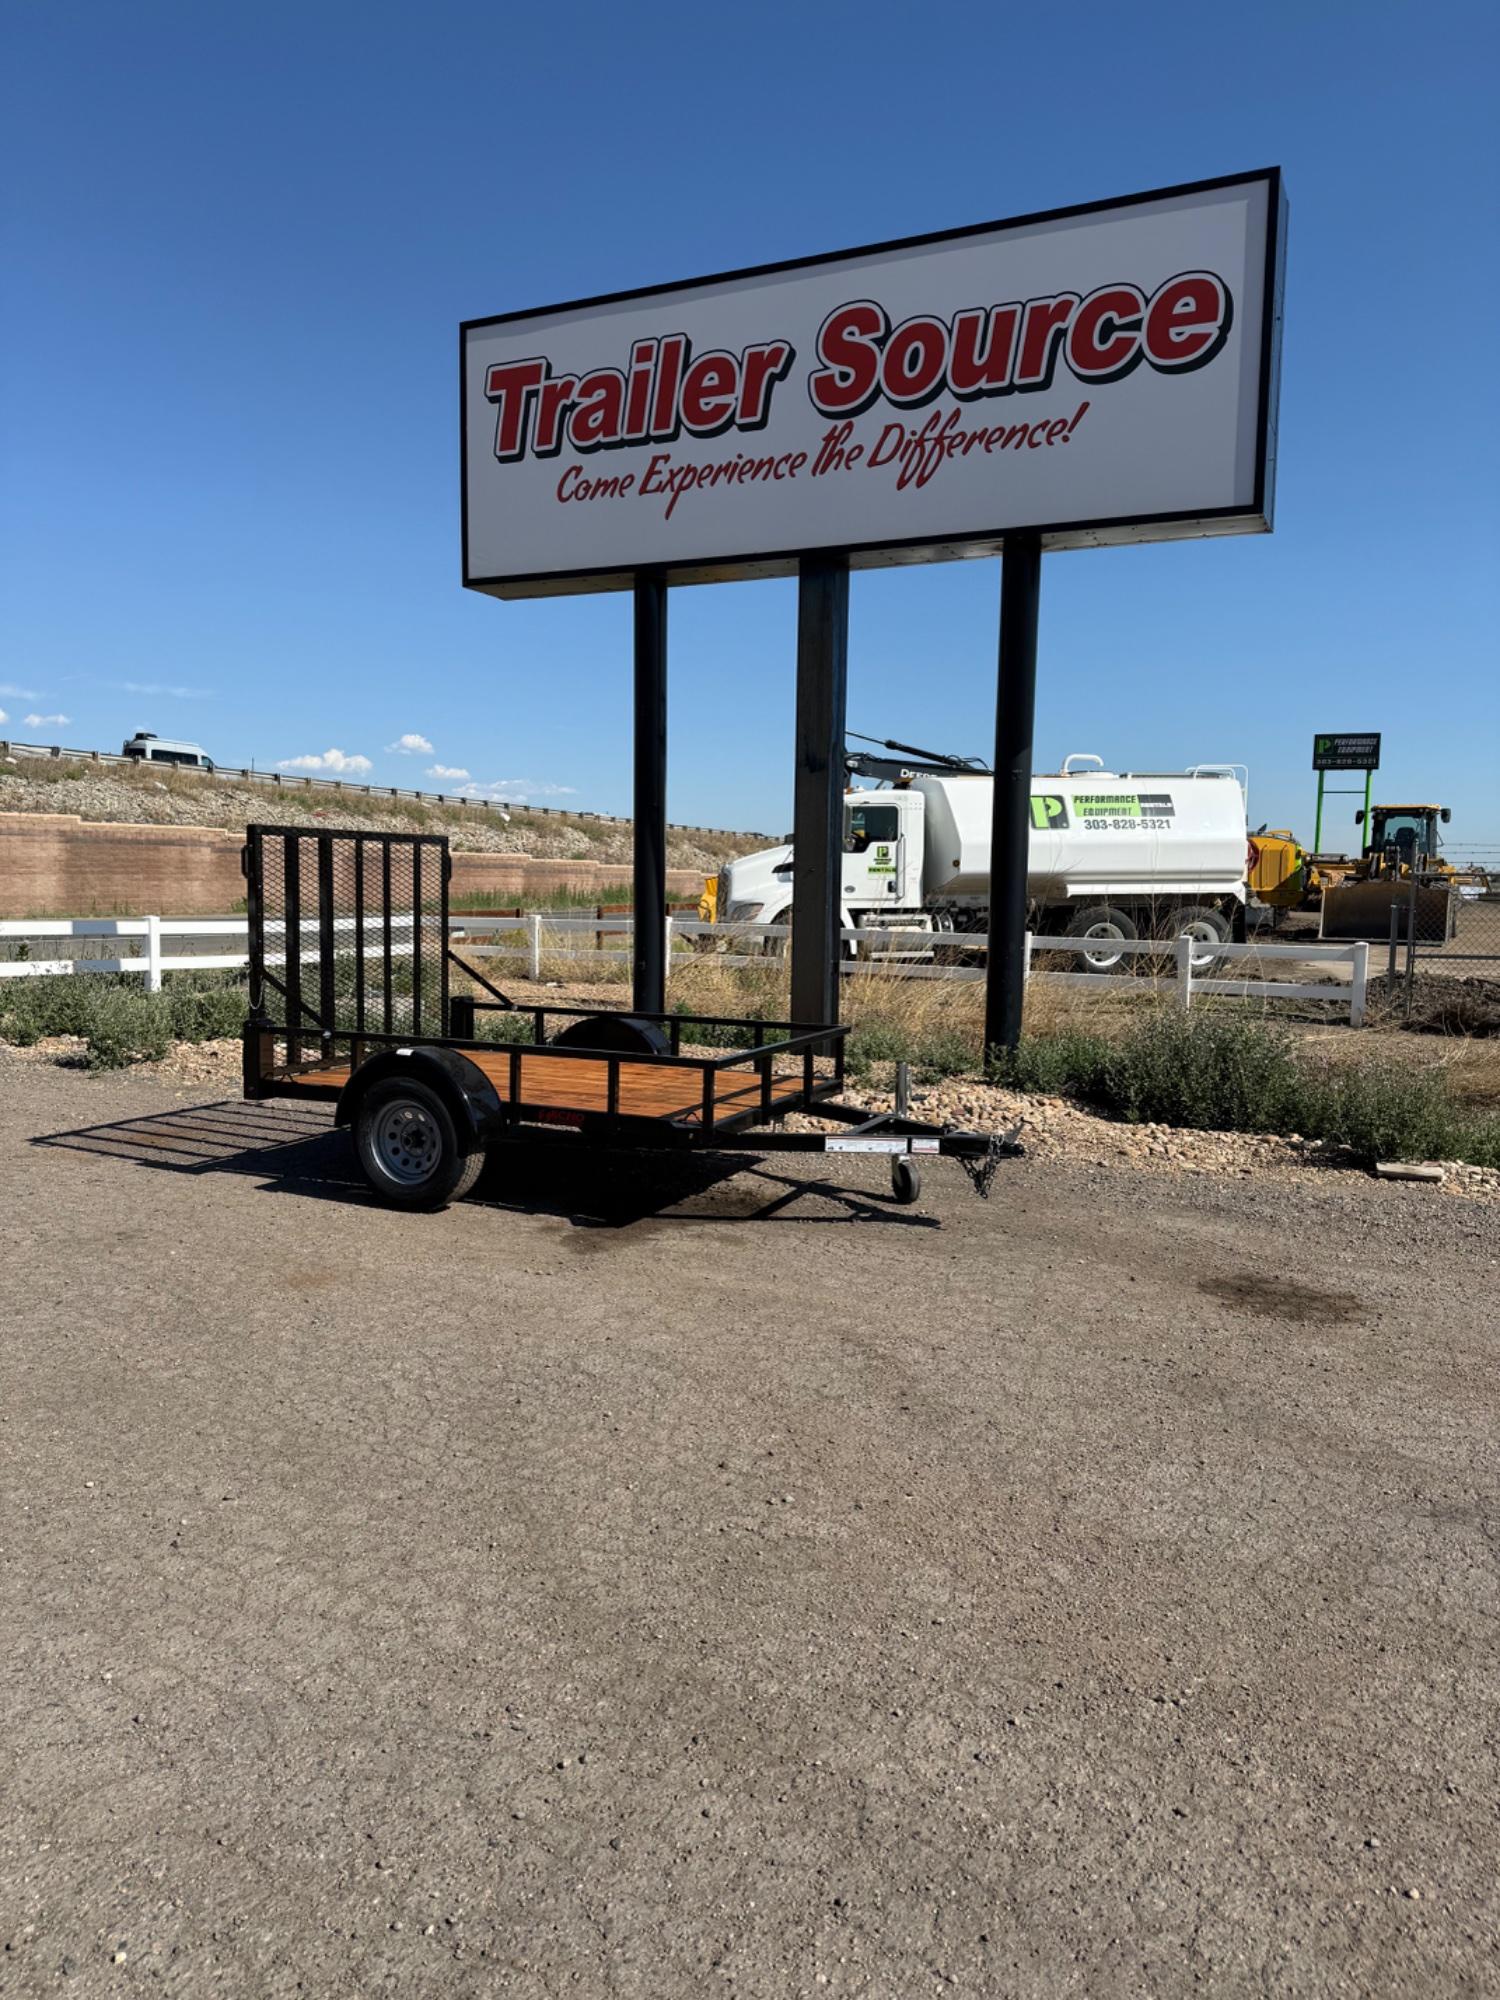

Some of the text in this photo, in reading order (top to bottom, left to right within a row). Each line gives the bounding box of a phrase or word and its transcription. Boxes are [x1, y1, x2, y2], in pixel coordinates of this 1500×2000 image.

[485, 270, 1234, 464] Trailer Source
[556, 401, 1091, 521] Come Experience the Difference!
[1073, 795, 1137, 803] PERFORMANCE
[1083, 808, 1132, 816] EQUIPMENT
[1084, 819, 1171, 830] 303-828-5321
